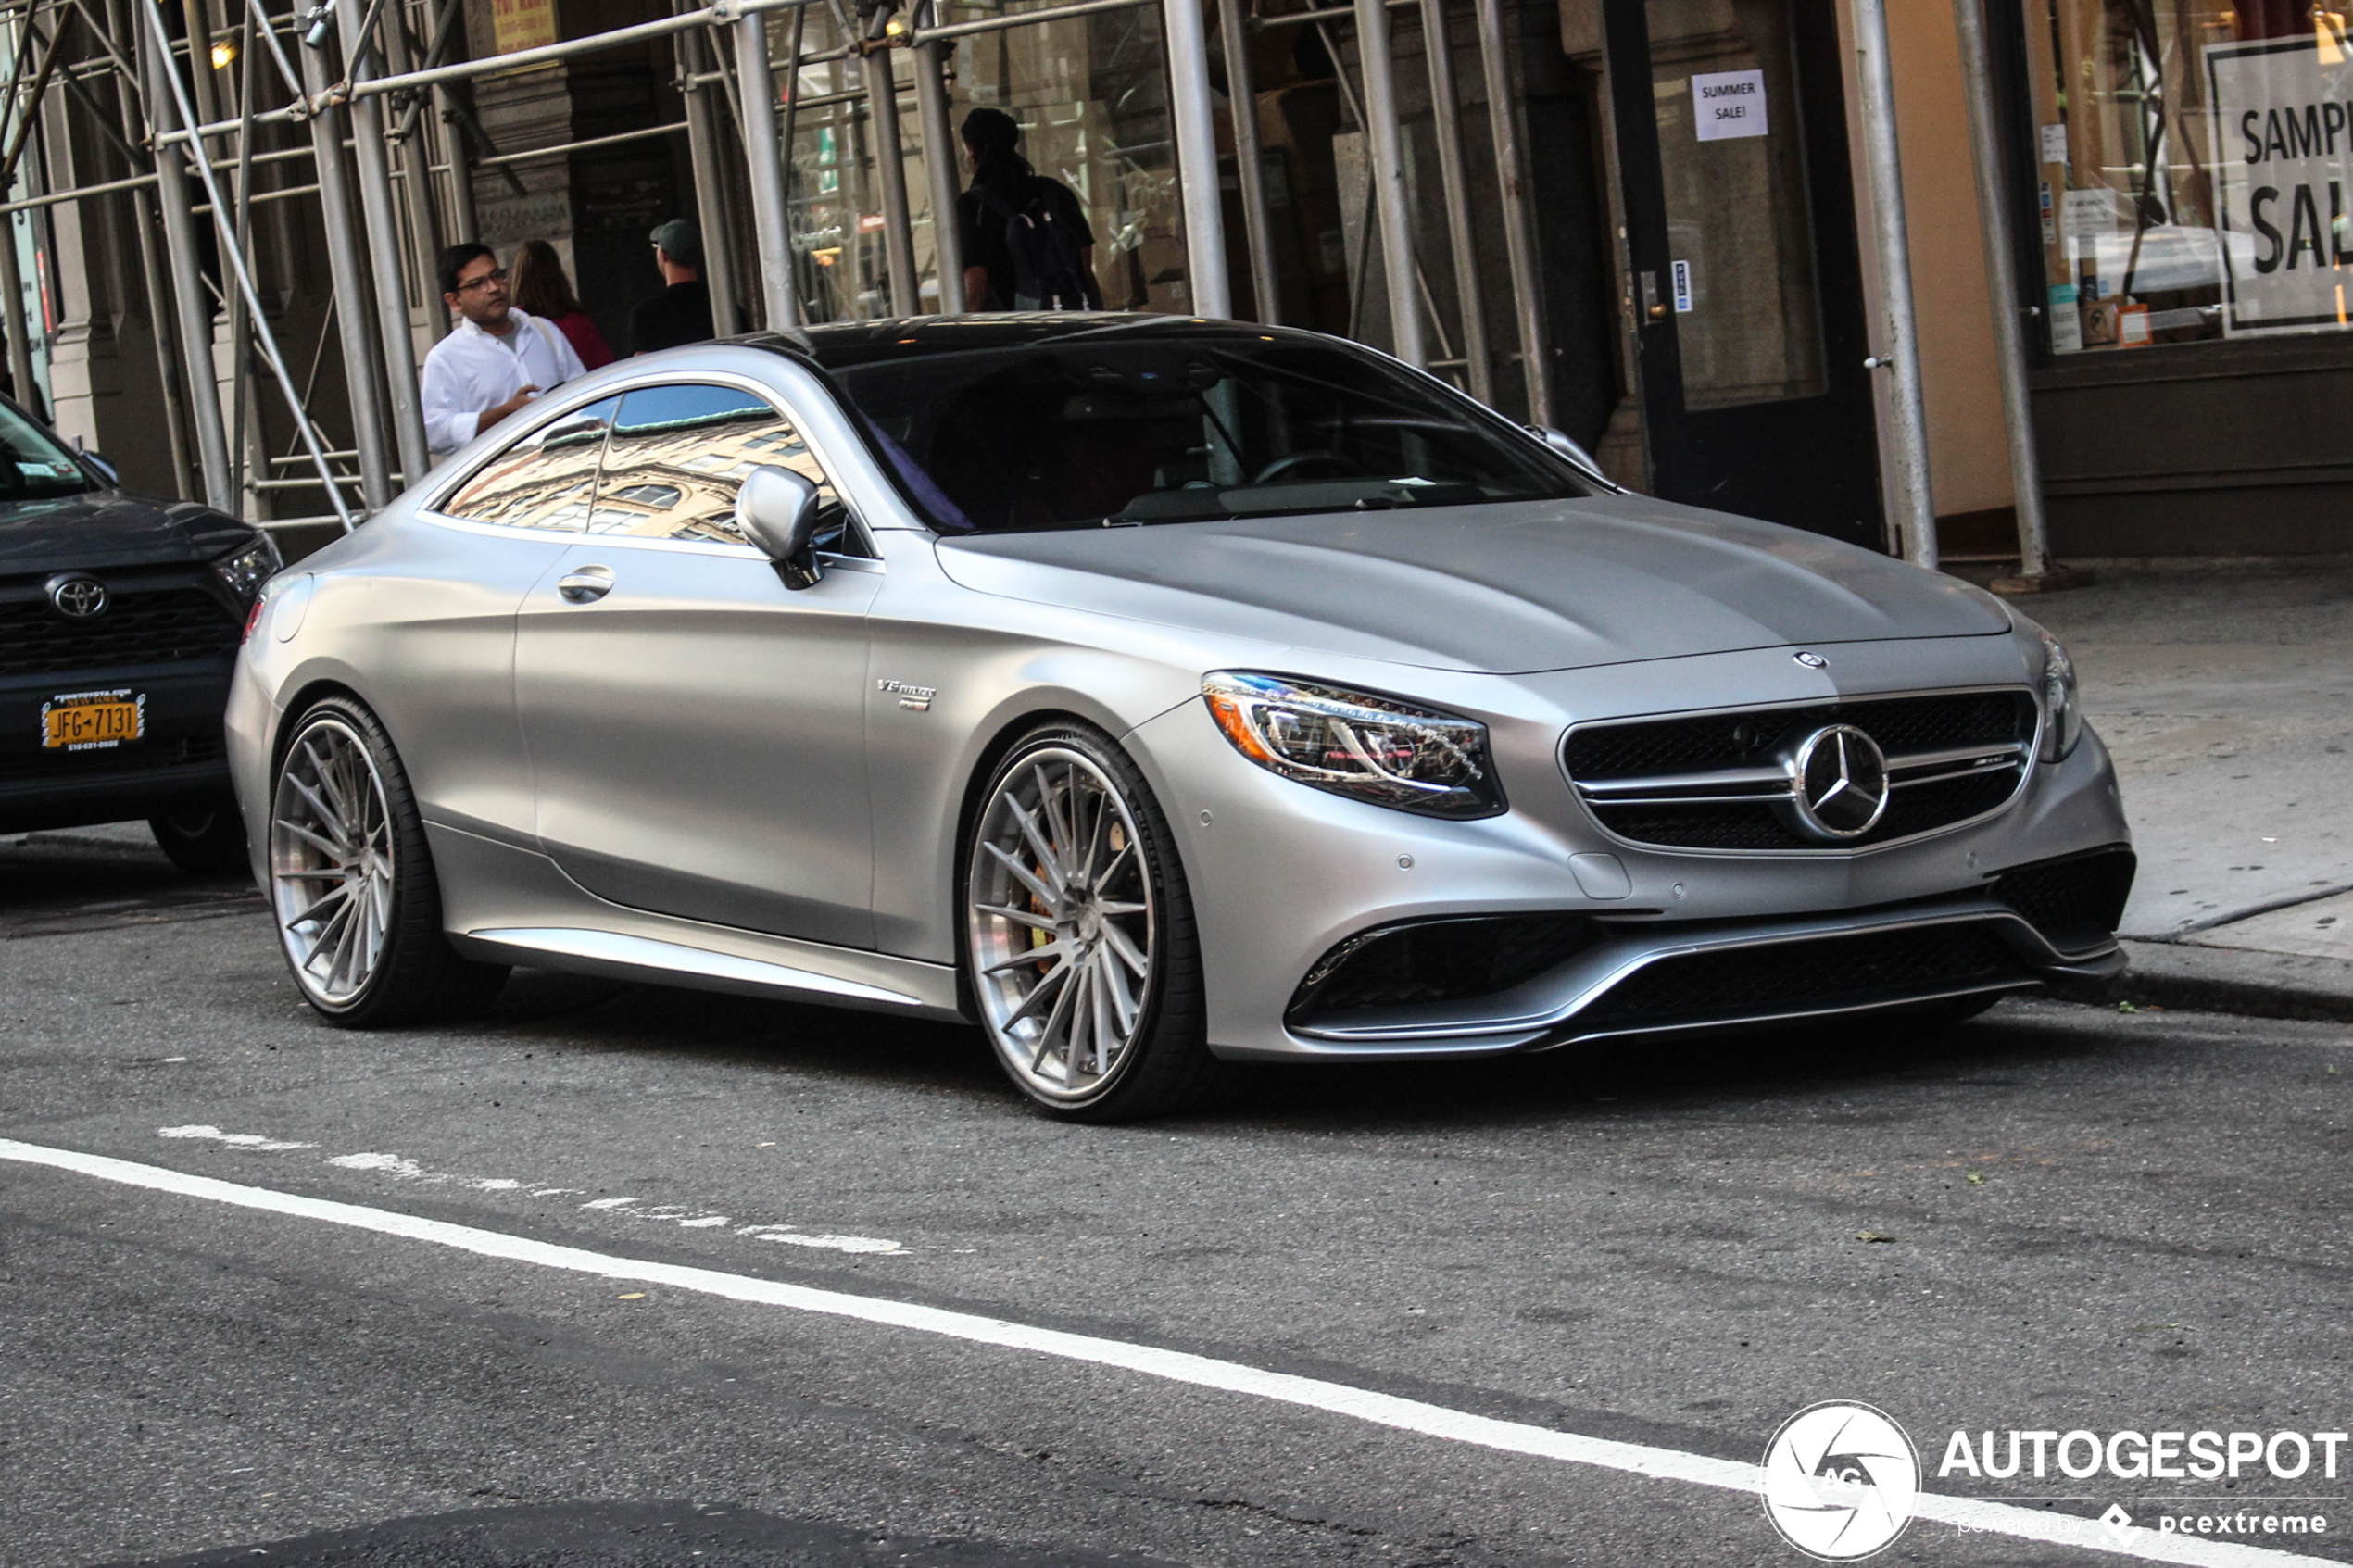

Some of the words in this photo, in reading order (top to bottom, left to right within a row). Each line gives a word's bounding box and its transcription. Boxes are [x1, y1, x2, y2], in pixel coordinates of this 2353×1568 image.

[1702, 82, 1755, 98] SUMMER
[1715, 106, 1746, 120] SALE!
[53, 711, 82, 738] JFG
[94, 707, 132, 734] 7131
